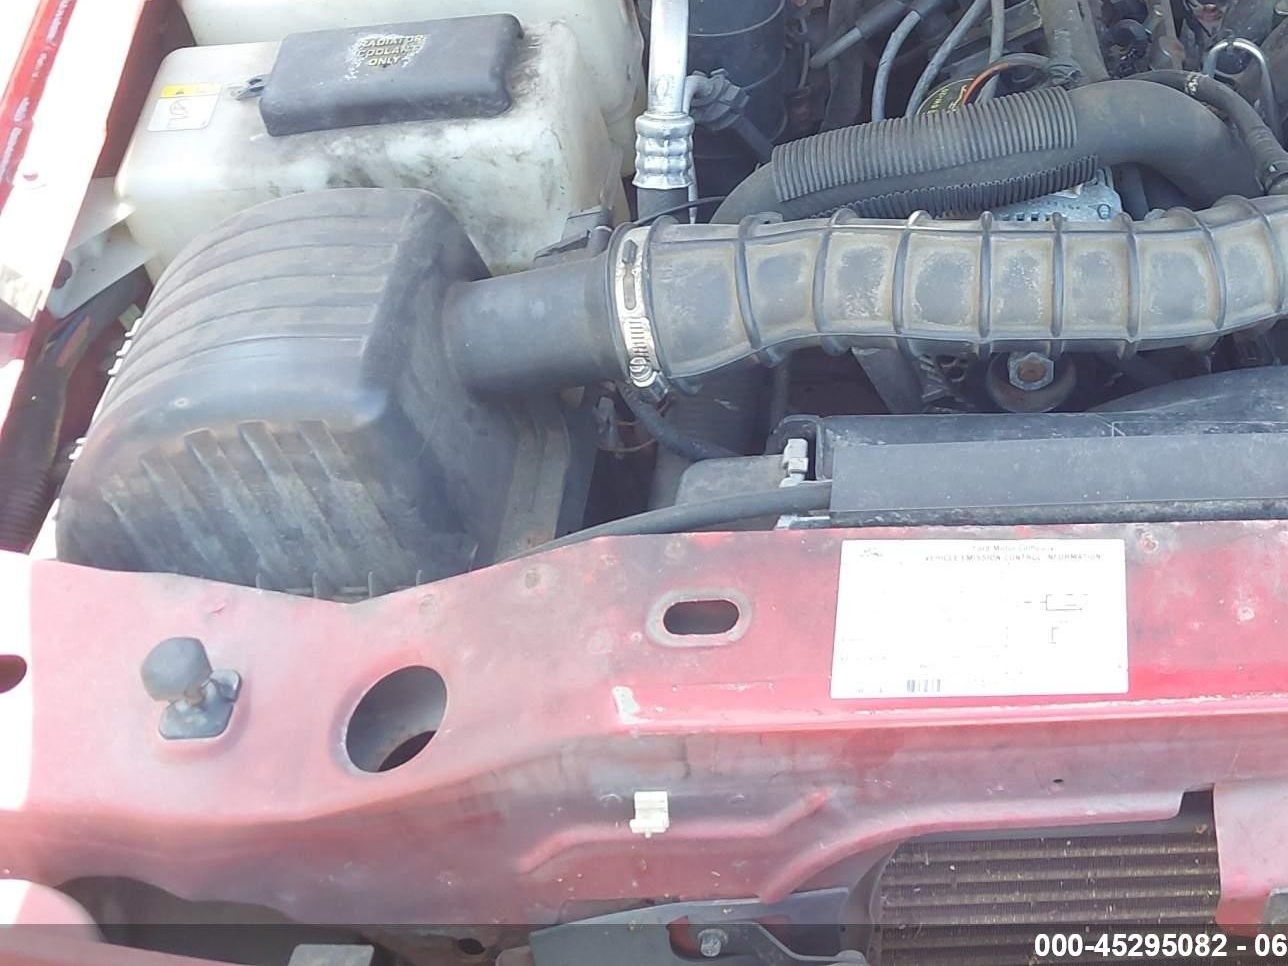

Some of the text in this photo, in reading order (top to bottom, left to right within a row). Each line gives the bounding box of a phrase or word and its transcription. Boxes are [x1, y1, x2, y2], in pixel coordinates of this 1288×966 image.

[359, 35, 425, 47] RADIATOR
[367, 56, 401, 67] ONLY
[961, 553, 1001, 562] EMISSION
